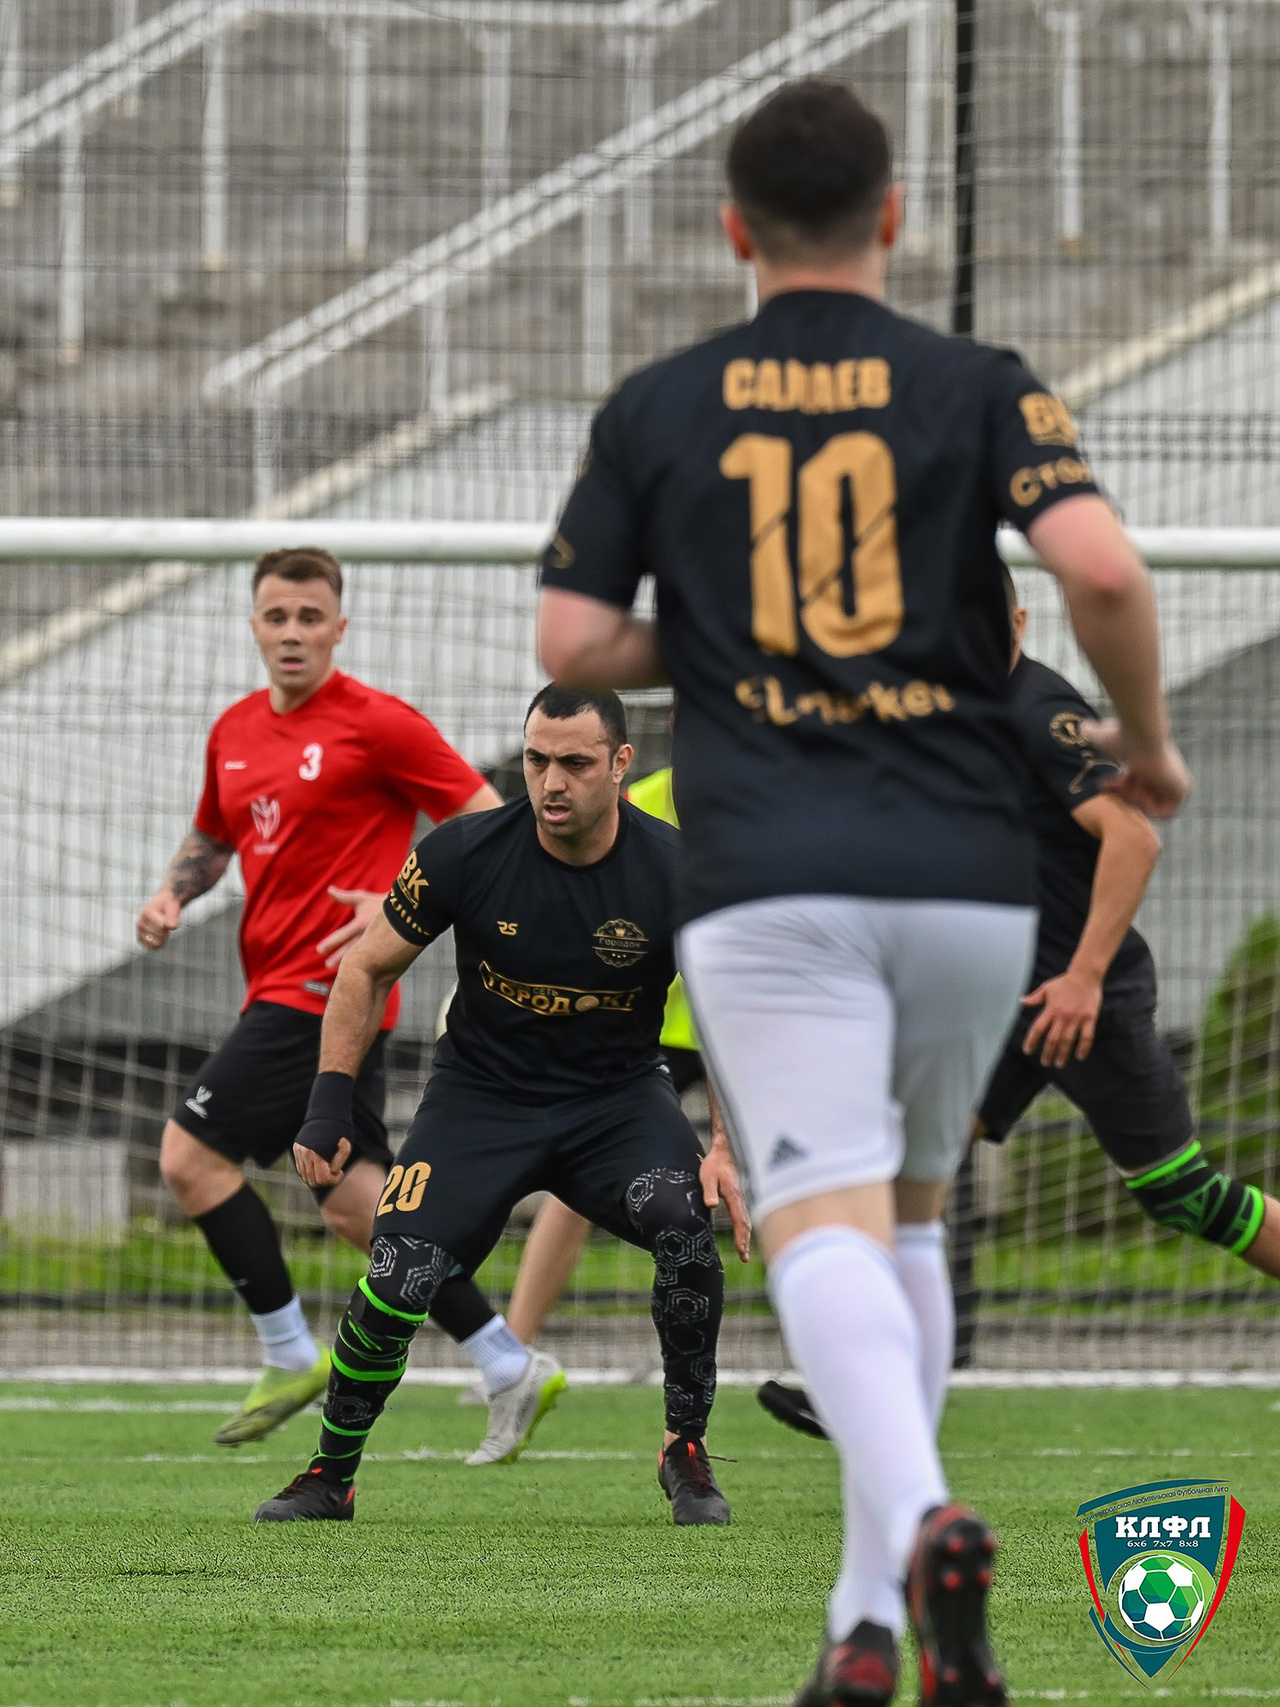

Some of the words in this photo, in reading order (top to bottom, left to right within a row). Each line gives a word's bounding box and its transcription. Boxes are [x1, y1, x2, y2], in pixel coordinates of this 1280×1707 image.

[720, 431, 905, 658] 10
[298, 742, 323, 781] 3
[376, 1162, 431, 1217] 20
